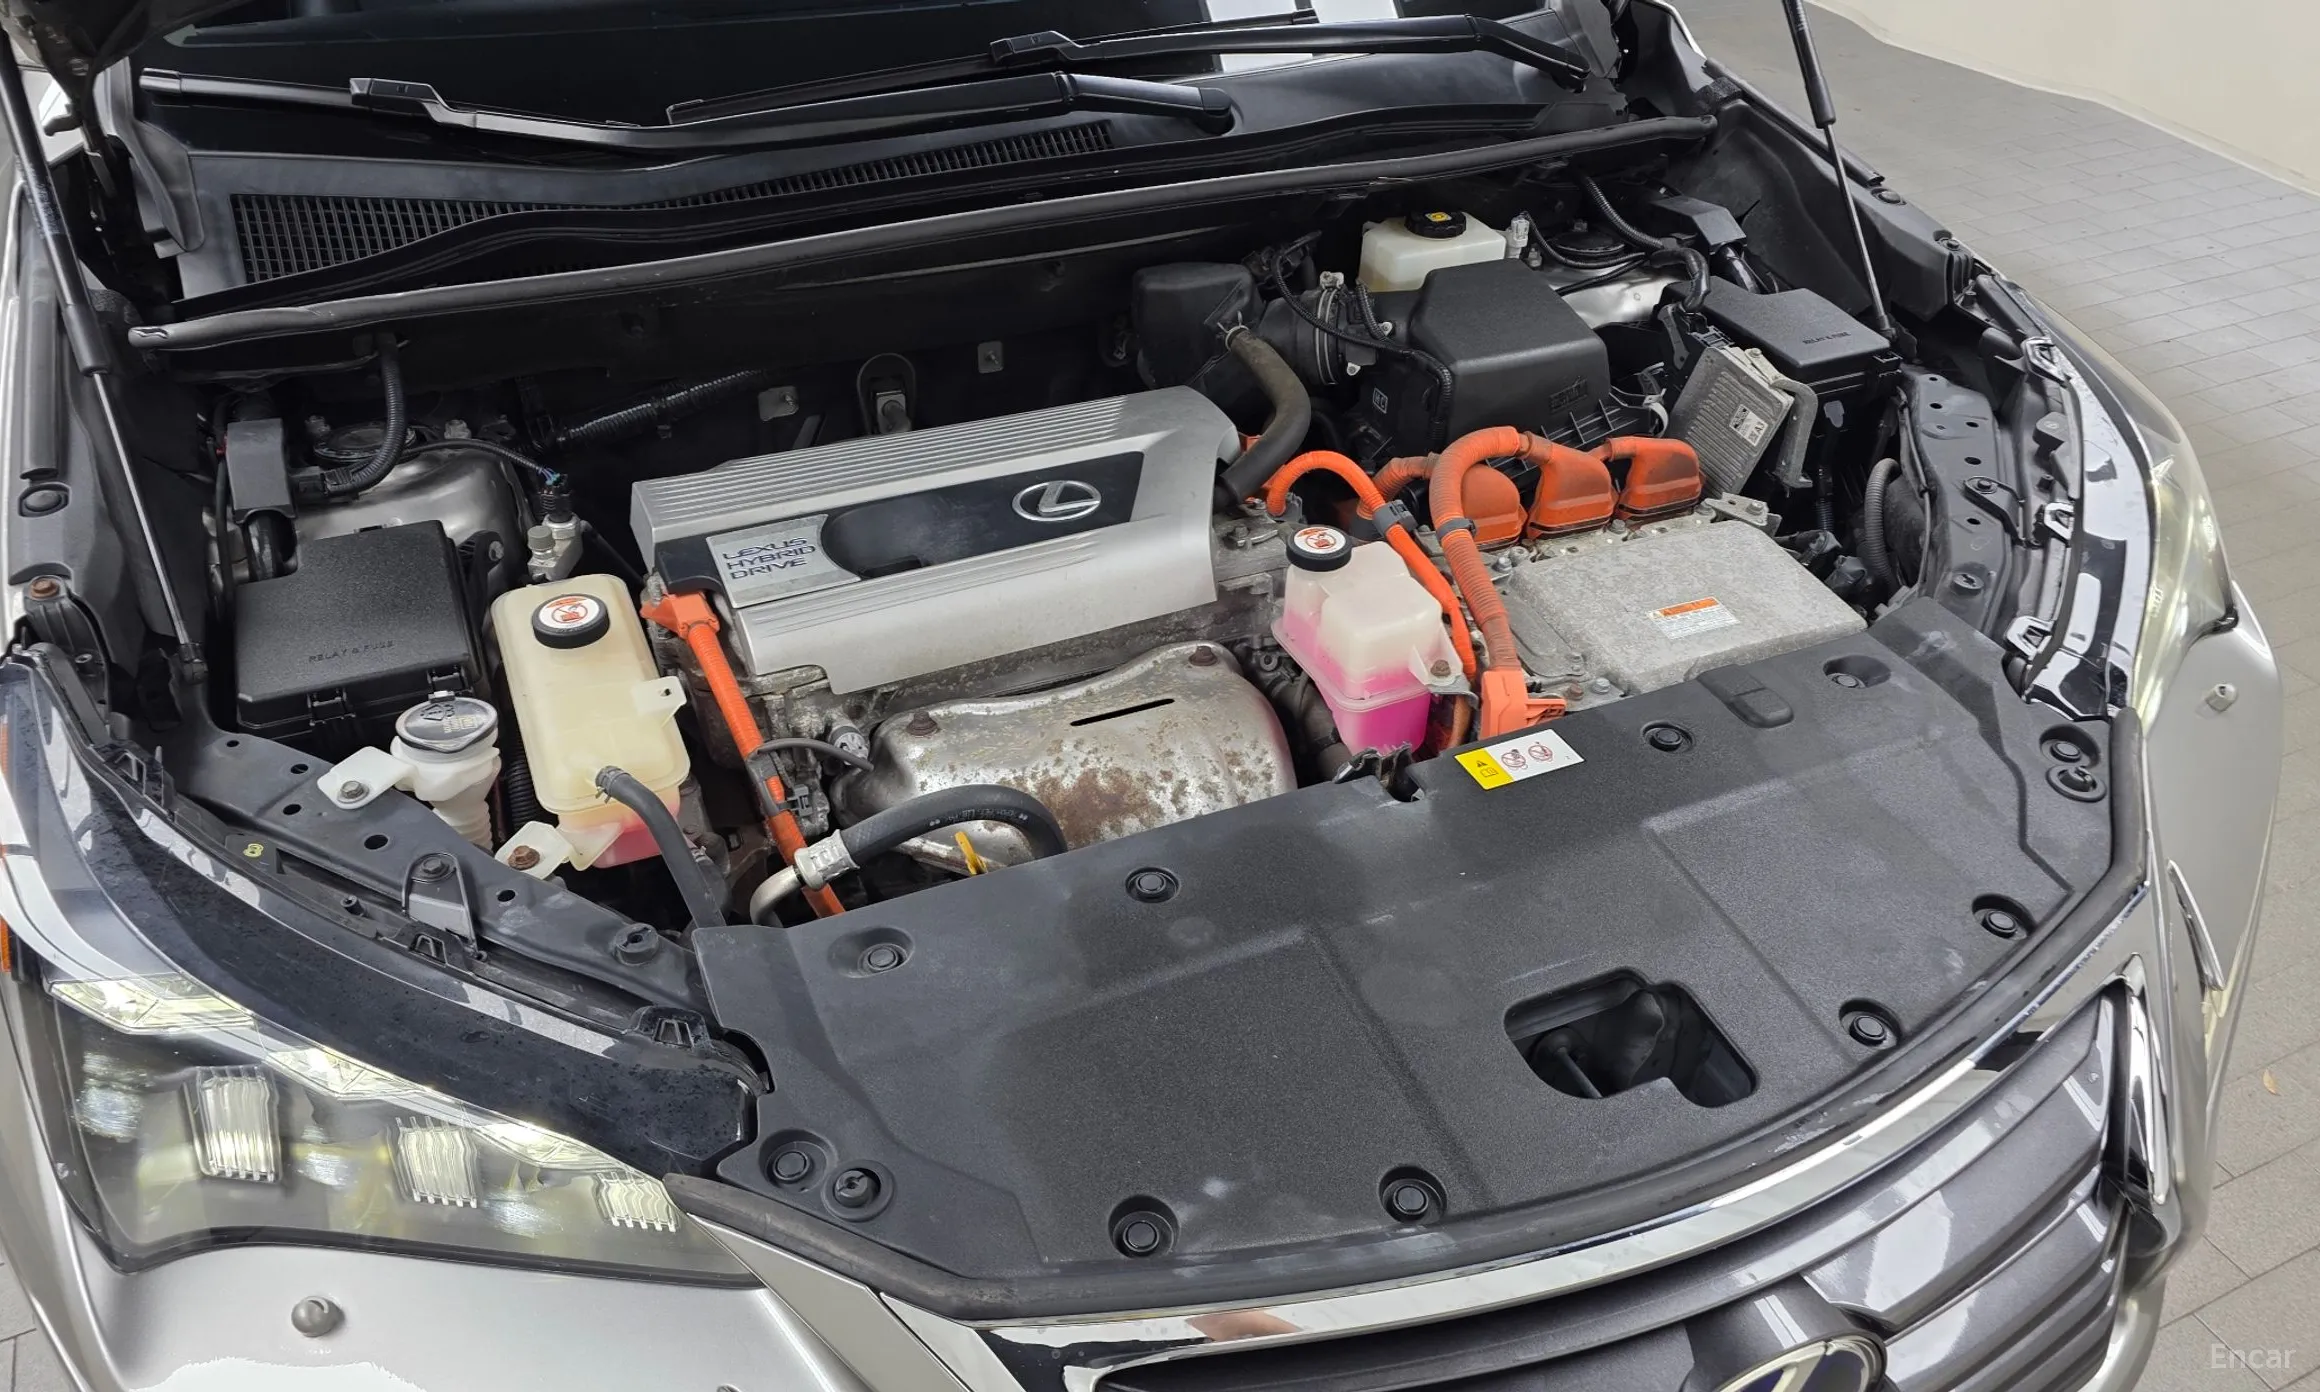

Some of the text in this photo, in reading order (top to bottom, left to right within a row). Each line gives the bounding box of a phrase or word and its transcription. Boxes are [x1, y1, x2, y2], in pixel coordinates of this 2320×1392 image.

[723, 537, 807, 559] LEXUS
[727, 545, 816, 569] HYBRID
[730, 557, 807, 579] DRIVE
[309, 648, 347, 662] RELAY
